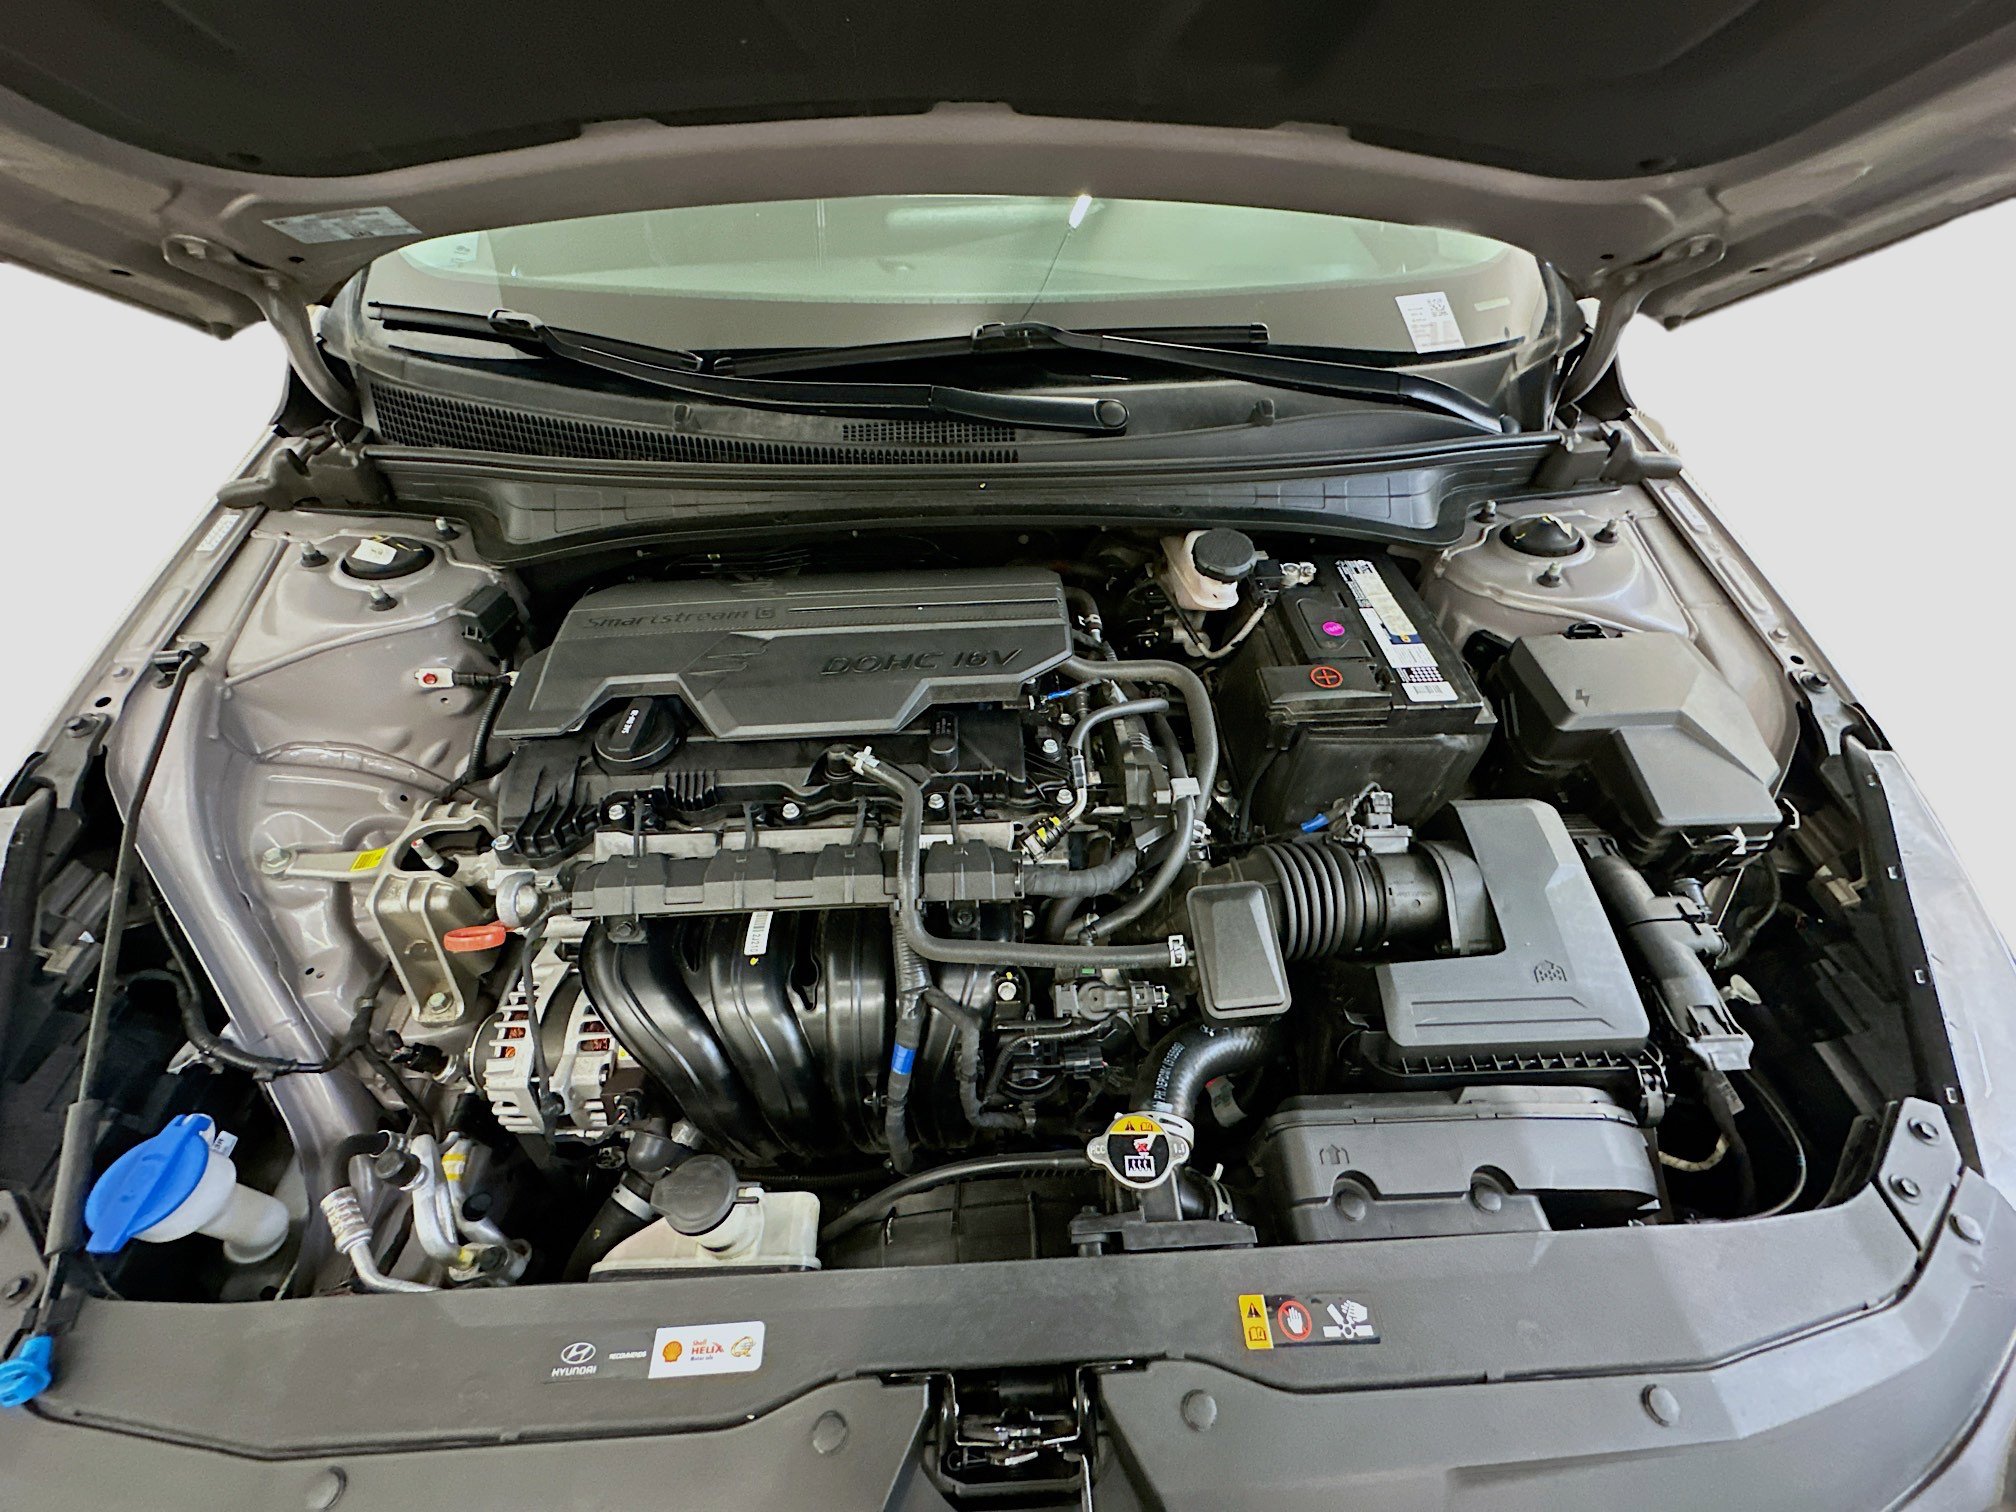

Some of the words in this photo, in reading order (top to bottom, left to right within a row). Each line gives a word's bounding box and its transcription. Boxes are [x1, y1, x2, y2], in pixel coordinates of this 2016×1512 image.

[583, 609, 749, 630] Smartstream
[820, 651, 944, 676] DOHC
[952, 648, 1022, 669] 16V
[691, 1343, 724, 1354] HELIX
[551, 1365, 597, 1377] HYUNDAI
